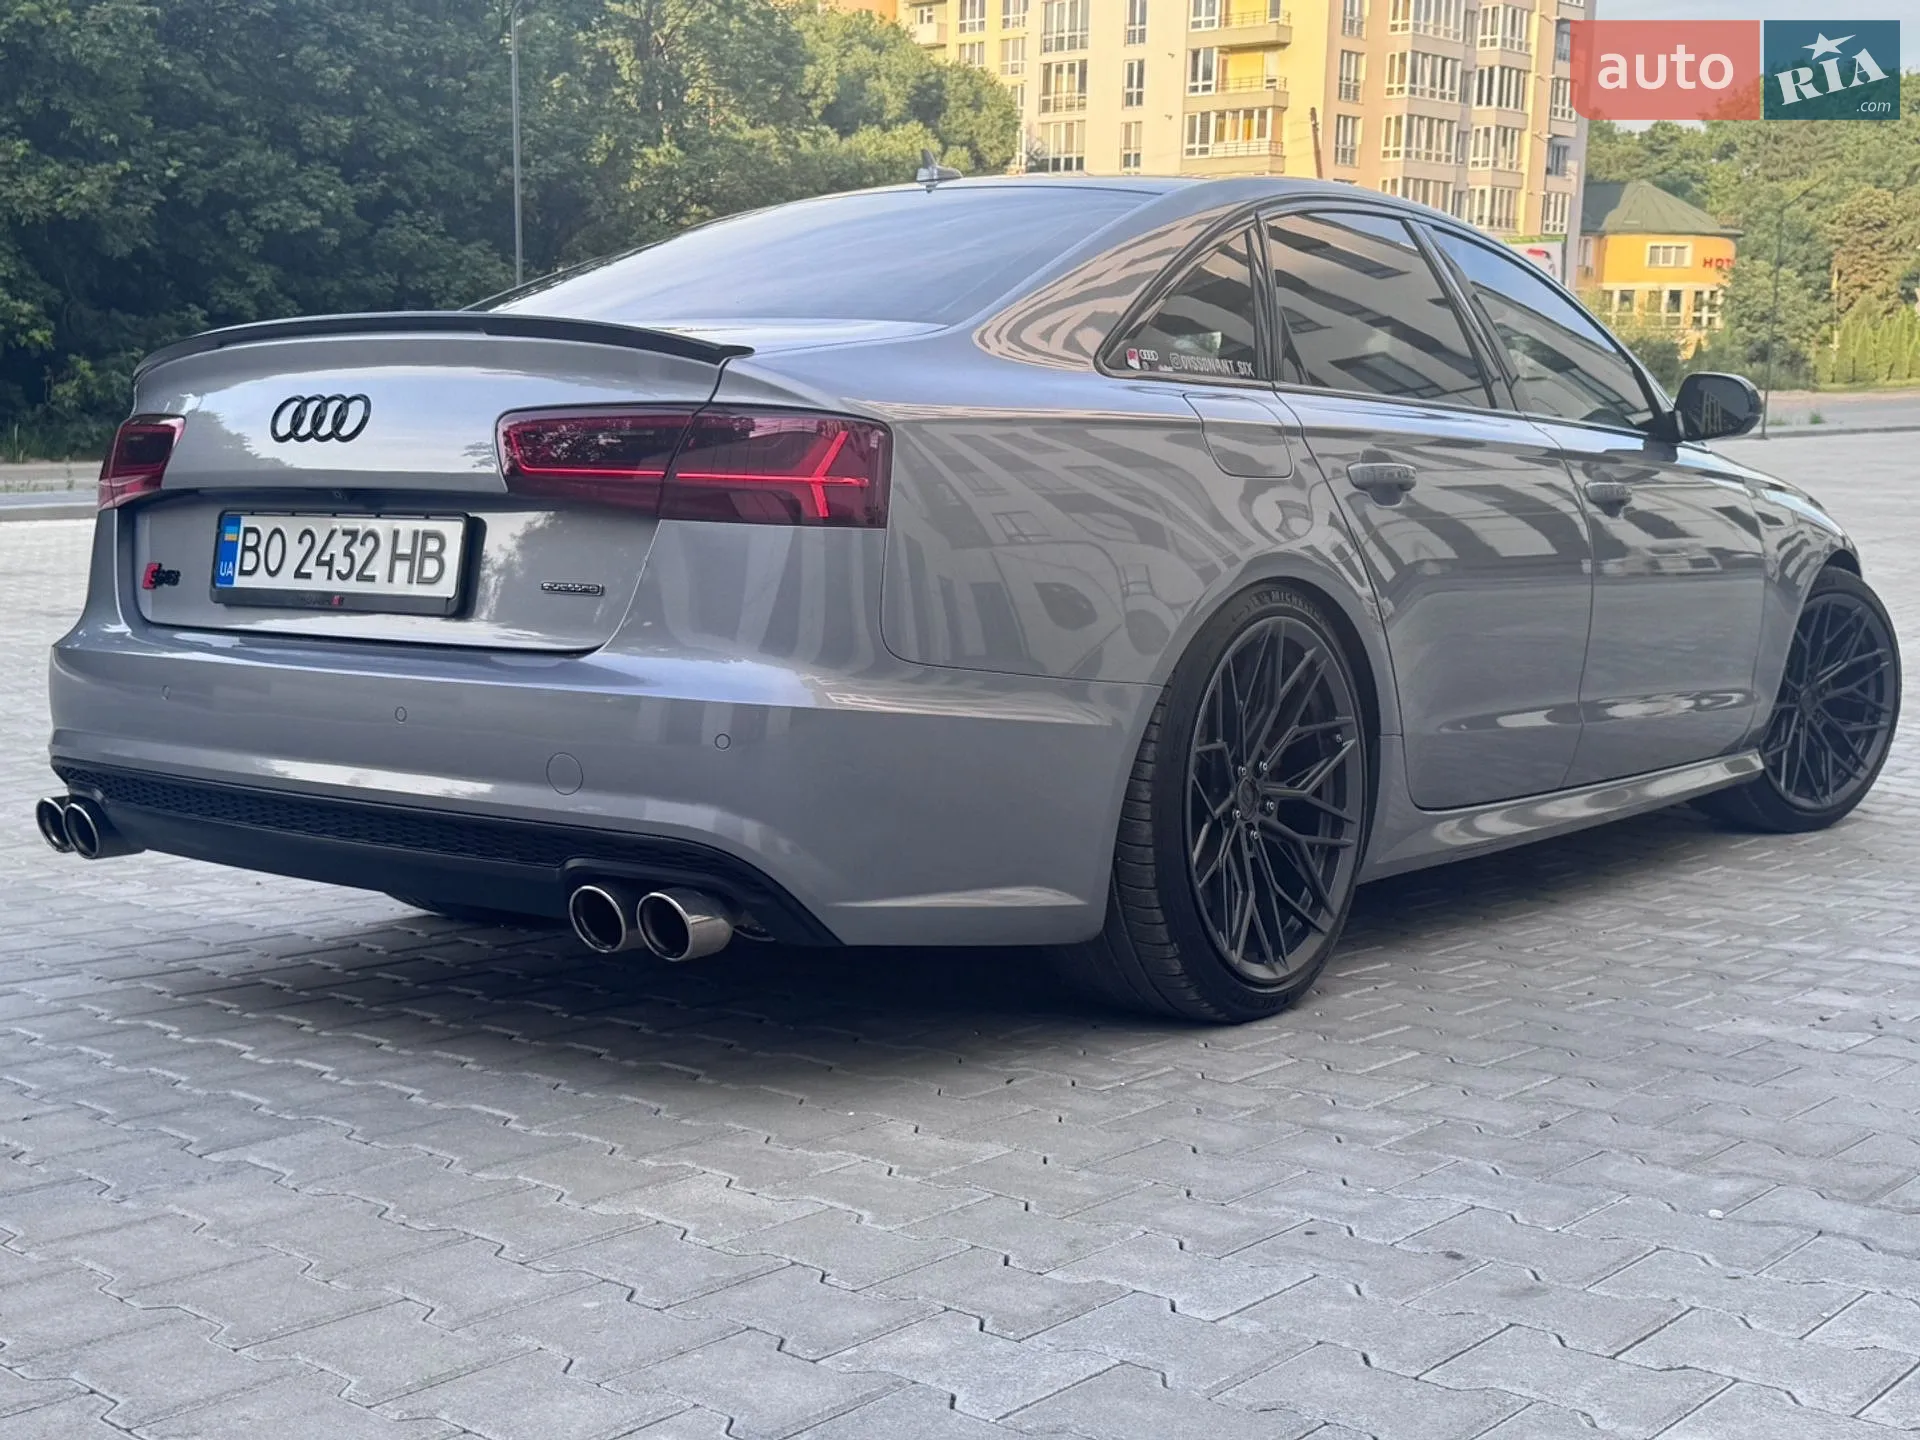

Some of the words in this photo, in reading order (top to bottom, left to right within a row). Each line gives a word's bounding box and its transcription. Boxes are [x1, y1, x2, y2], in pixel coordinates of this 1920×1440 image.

[220, 561, 233, 577] UA
[238, 526, 287, 577] BO
[293, 526, 381, 582] 2432
[388, 528, 446, 584] HB
